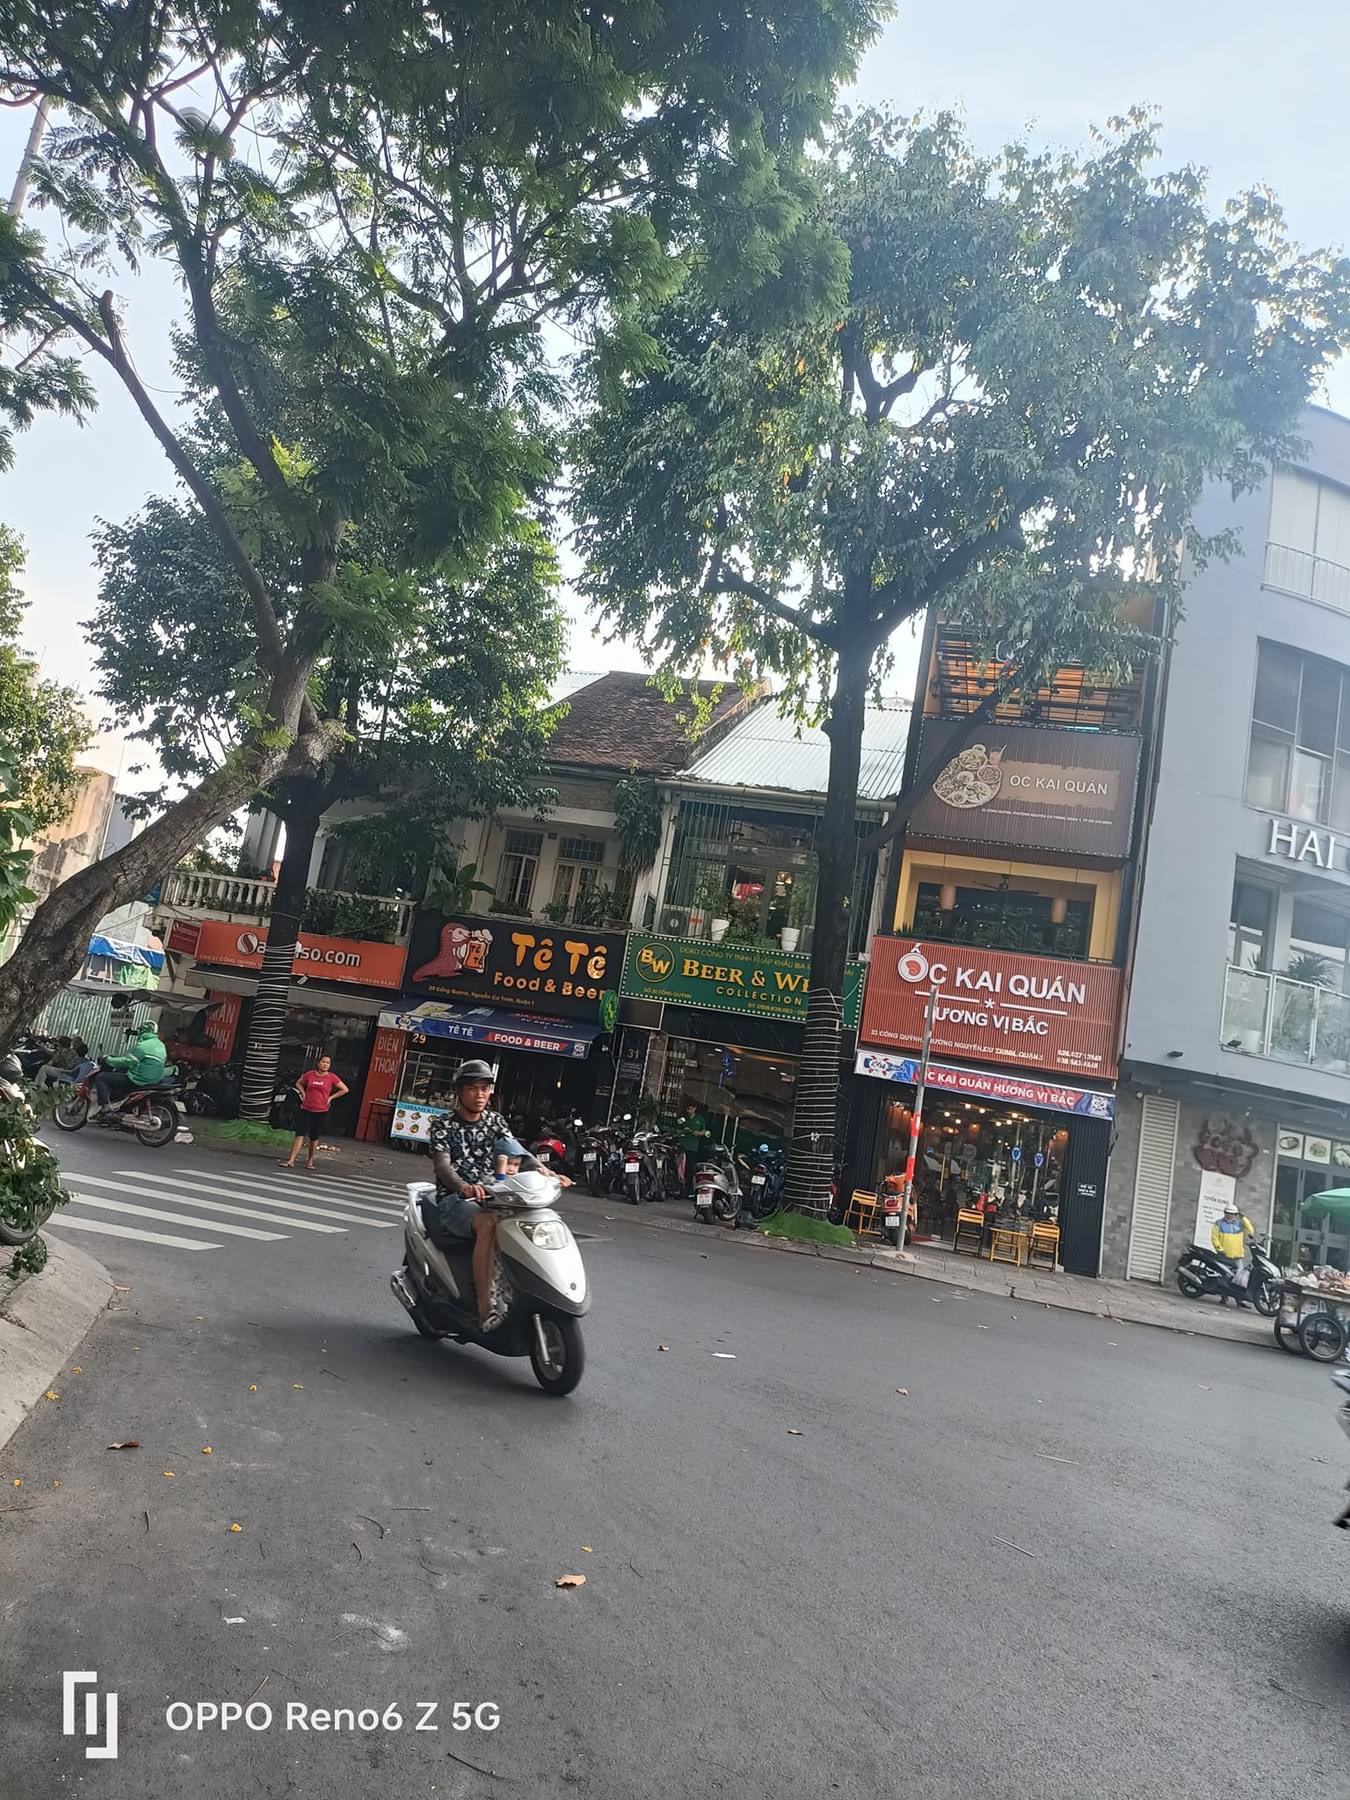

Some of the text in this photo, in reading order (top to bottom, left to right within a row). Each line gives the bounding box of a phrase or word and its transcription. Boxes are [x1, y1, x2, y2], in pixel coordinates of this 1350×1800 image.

[1035, 777, 1060, 790] KAI
[1267, 819, 1336, 870] HAI
[512, 931, 608, 980] Tê Tê
[493, 971, 607, 1001] Food & Beer
[682, 958, 809, 993] BEER & WI
[955, 966, 1002, 993] KAI
[1008, 975, 1087, 1005] QUÁN
[716, 985, 802, 1006] COLLECTION
[448, 1024, 474, 1037] TÊ TÊ
[924, 1005, 1049, 1036] HƯƠNG VỊ BẮC
[411, 1033, 427, 1045] 29
[494, 1032, 522, 1046] FOOD
[523, 1037, 532, 1047] &
[533, 1038, 561, 1052] BEER
[627, 1048, 640, 1060] 31
[937, 1073, 957, 1085] KAI
[958, 1075, 992, 1092] QUÁN
[993, 1081, 1035, 1099] HƯƠNG
[1036, 1091, 1050, 1105] VỊ
[1050, 1089, 1076, 1107] BẮC
